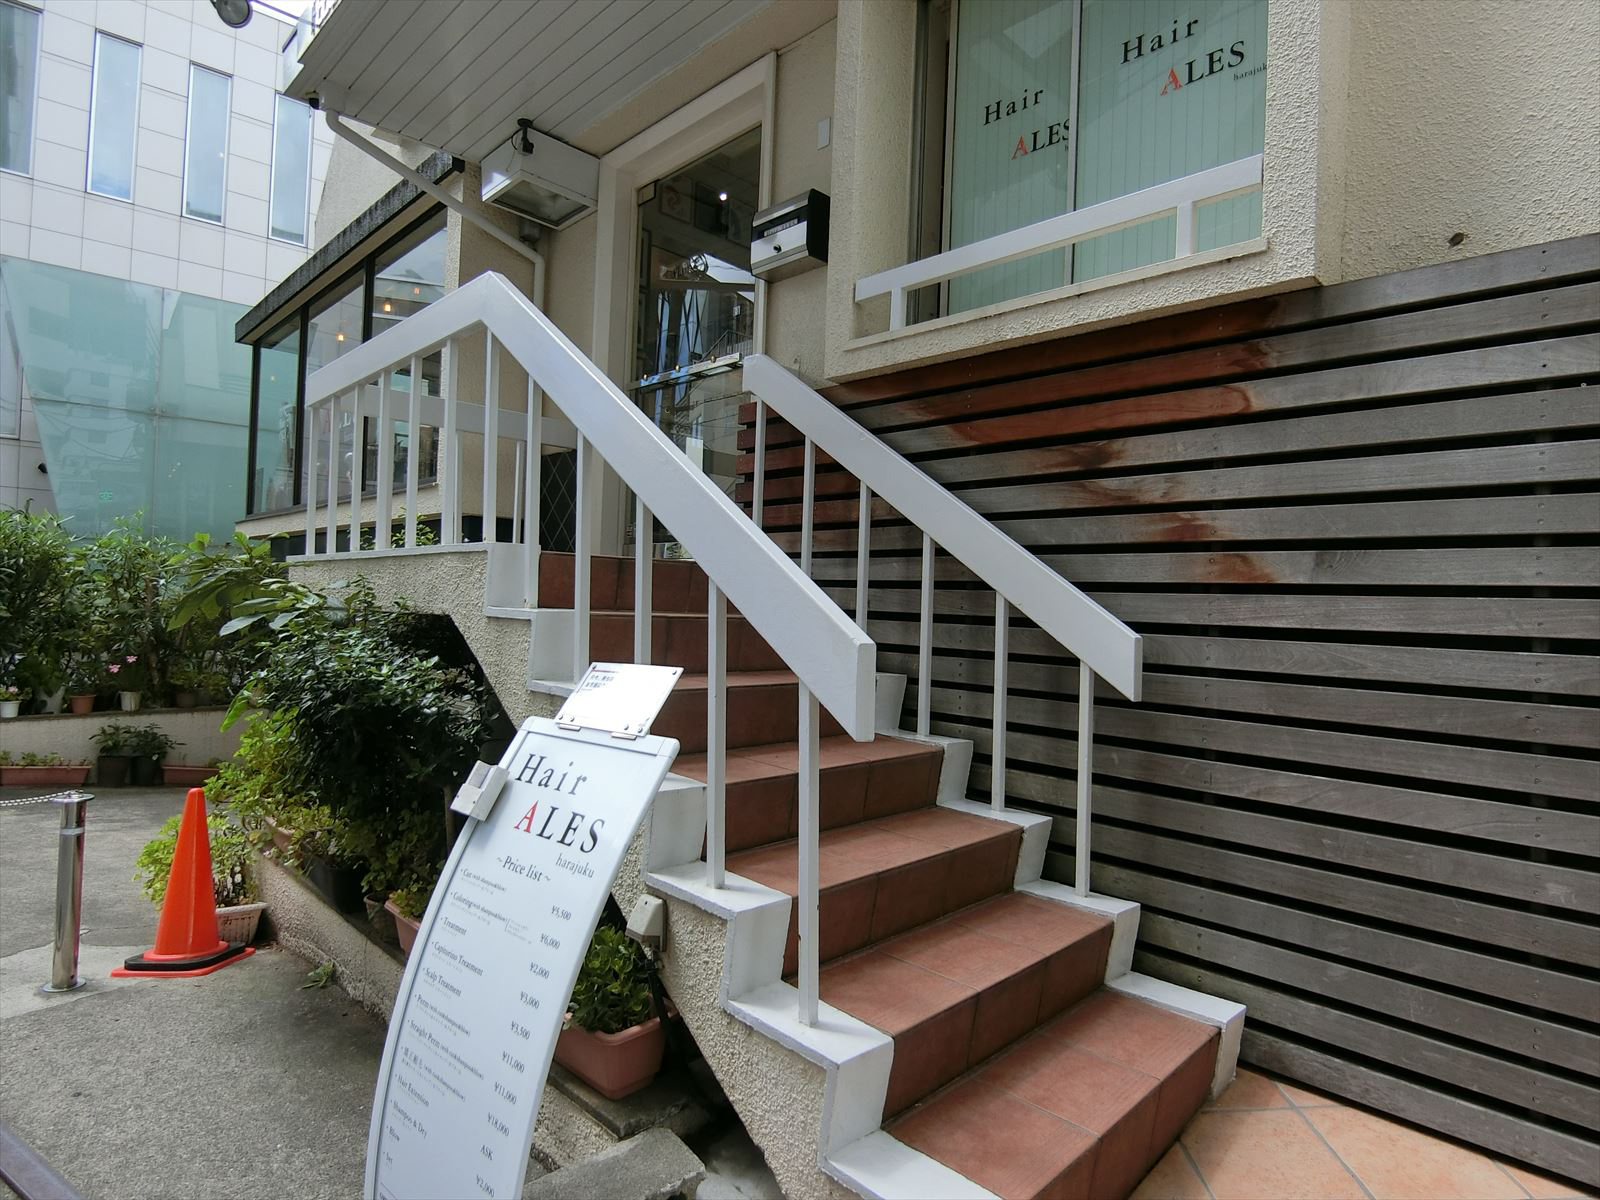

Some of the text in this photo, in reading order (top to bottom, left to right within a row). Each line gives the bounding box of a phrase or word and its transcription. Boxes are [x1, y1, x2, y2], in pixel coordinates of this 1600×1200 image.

[1120, 17, 1199, 65] Hair
[1159, 39, 1246, 97] ALES
[983, 88, 1044, 126] Hair
[514, 753, 588, 797] Hair
[513, 799, 606, 854] ALES
[555, 853, 596, 879] harajuku
[551, 905, 572, 921] ¥5,500
[540, 932, 561, 950] ¥6,000
[529, 961, 550, 979] ¥2,000
[520, 991, 540, 1010] ¥3,000
[501, 1051, 525, 1074] ¥11,000
[480, 1144, 494, 1161] ASK
